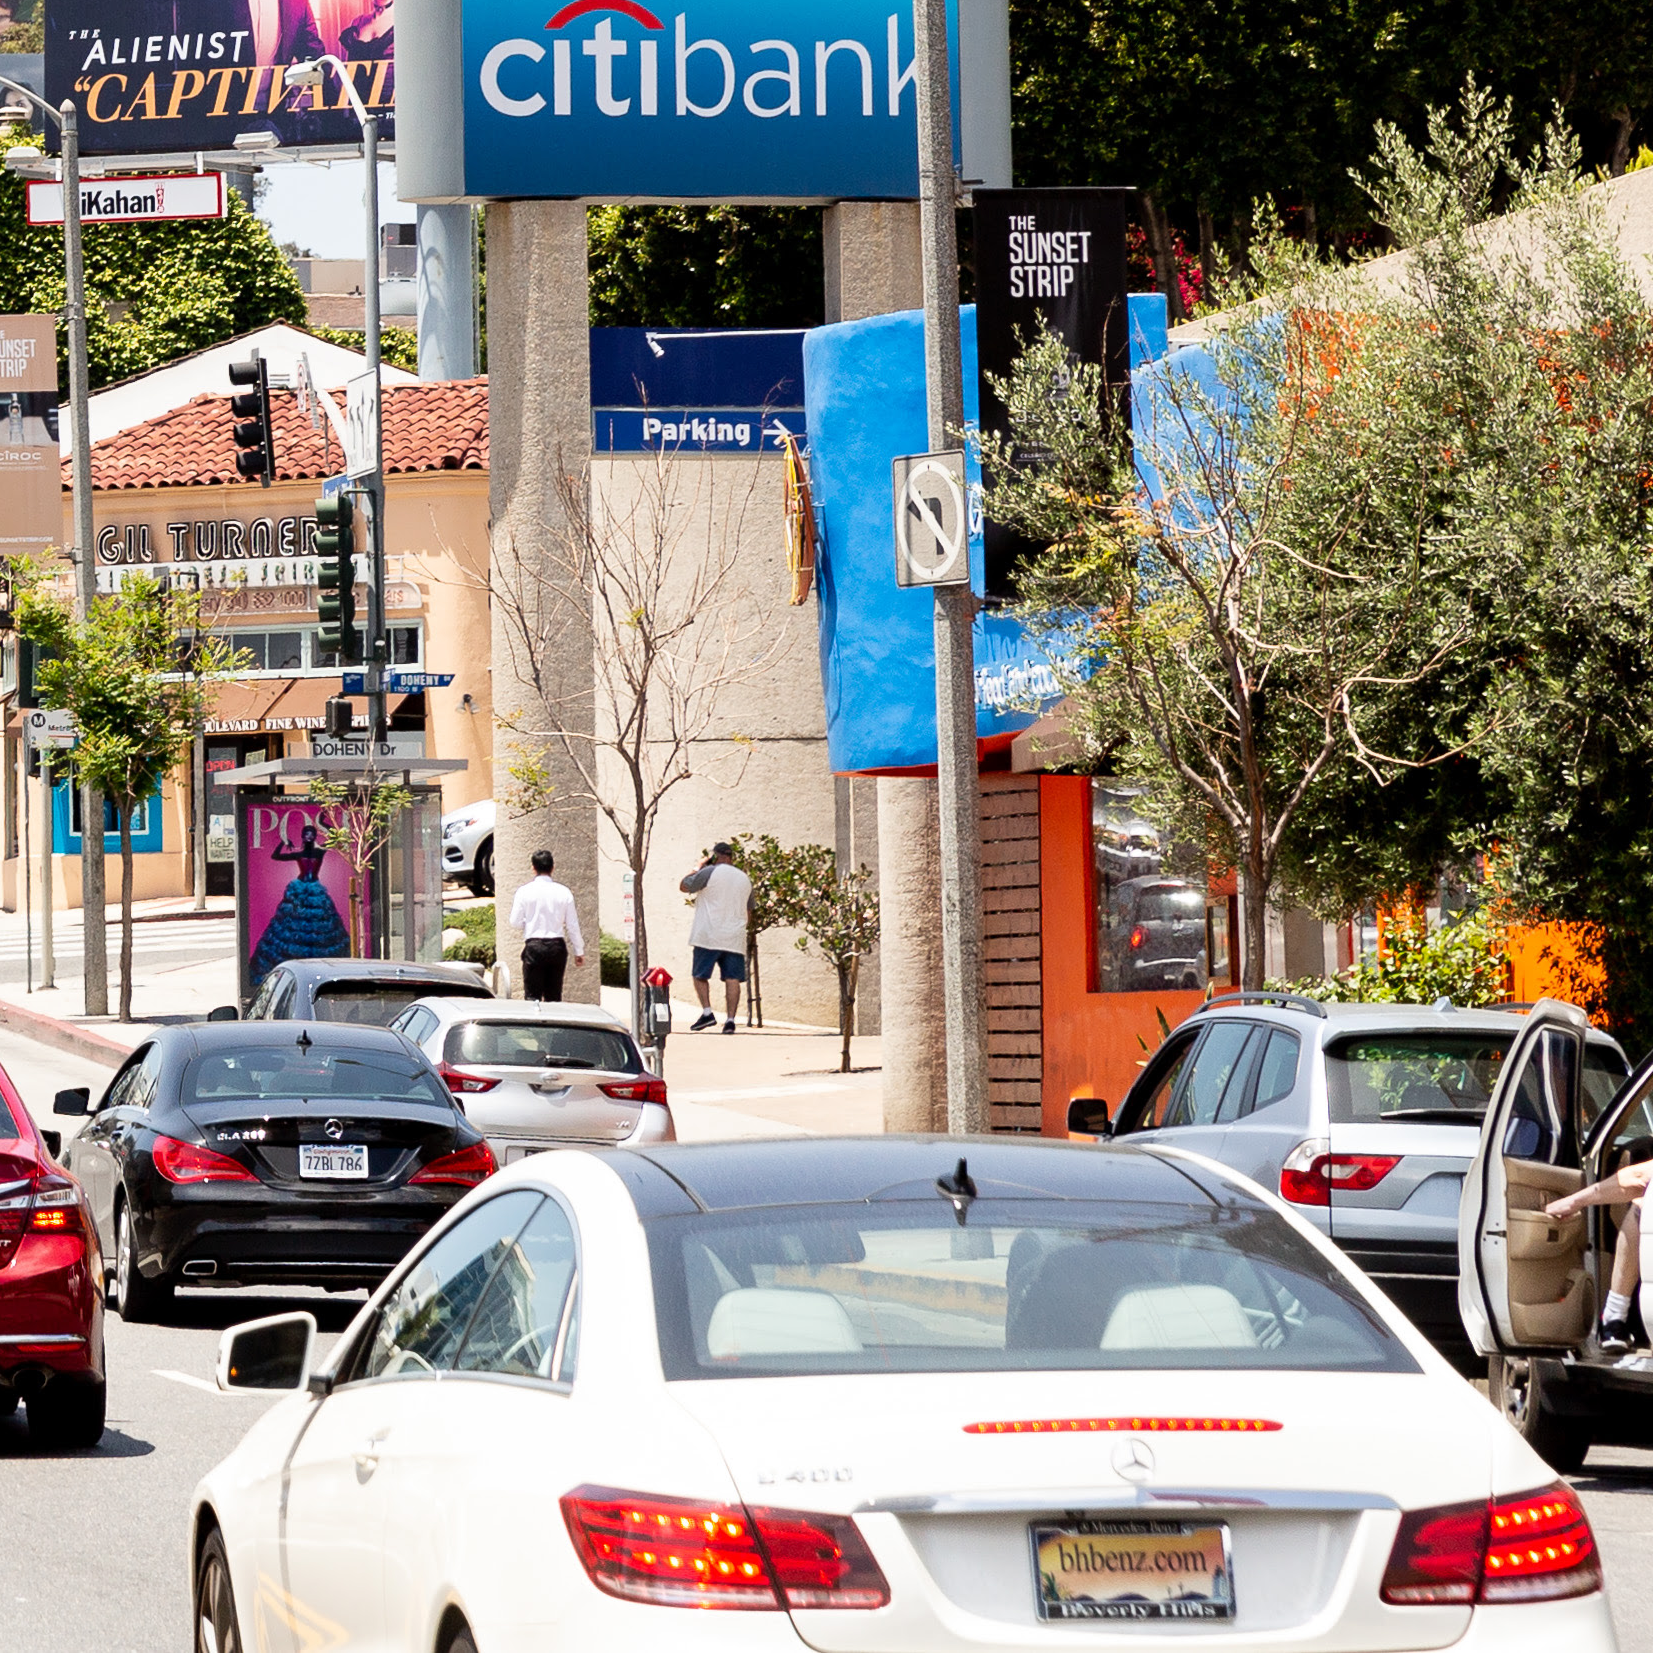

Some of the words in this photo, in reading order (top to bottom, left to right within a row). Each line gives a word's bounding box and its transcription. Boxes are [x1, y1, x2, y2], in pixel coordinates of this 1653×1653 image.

[68, 29, 100, 40] THE
[82, 31, 248, 71] ALIENIST
[480, 12, 919, 117] citibank
[1009, 215, 1036, 231] THE
[1009, 232, 1091, 264] SUNSET
[1010, 265, 1075, 297] STRIP
[643, 417, 751, 446] Parking
[96, 524, 154, 564] GIL
[400, 674, 439, 686] DOHENY
[265, 718, 293, 730] FINE
[312, 743, 374, 756] DOHENY
[380, 743, 397, 756] Dr
[210, 837, 234, 848] HELP
[1058, 1544, 1208, 1572] bhbenz.com
[1061, 1602, 1150, 1619] Beverly
